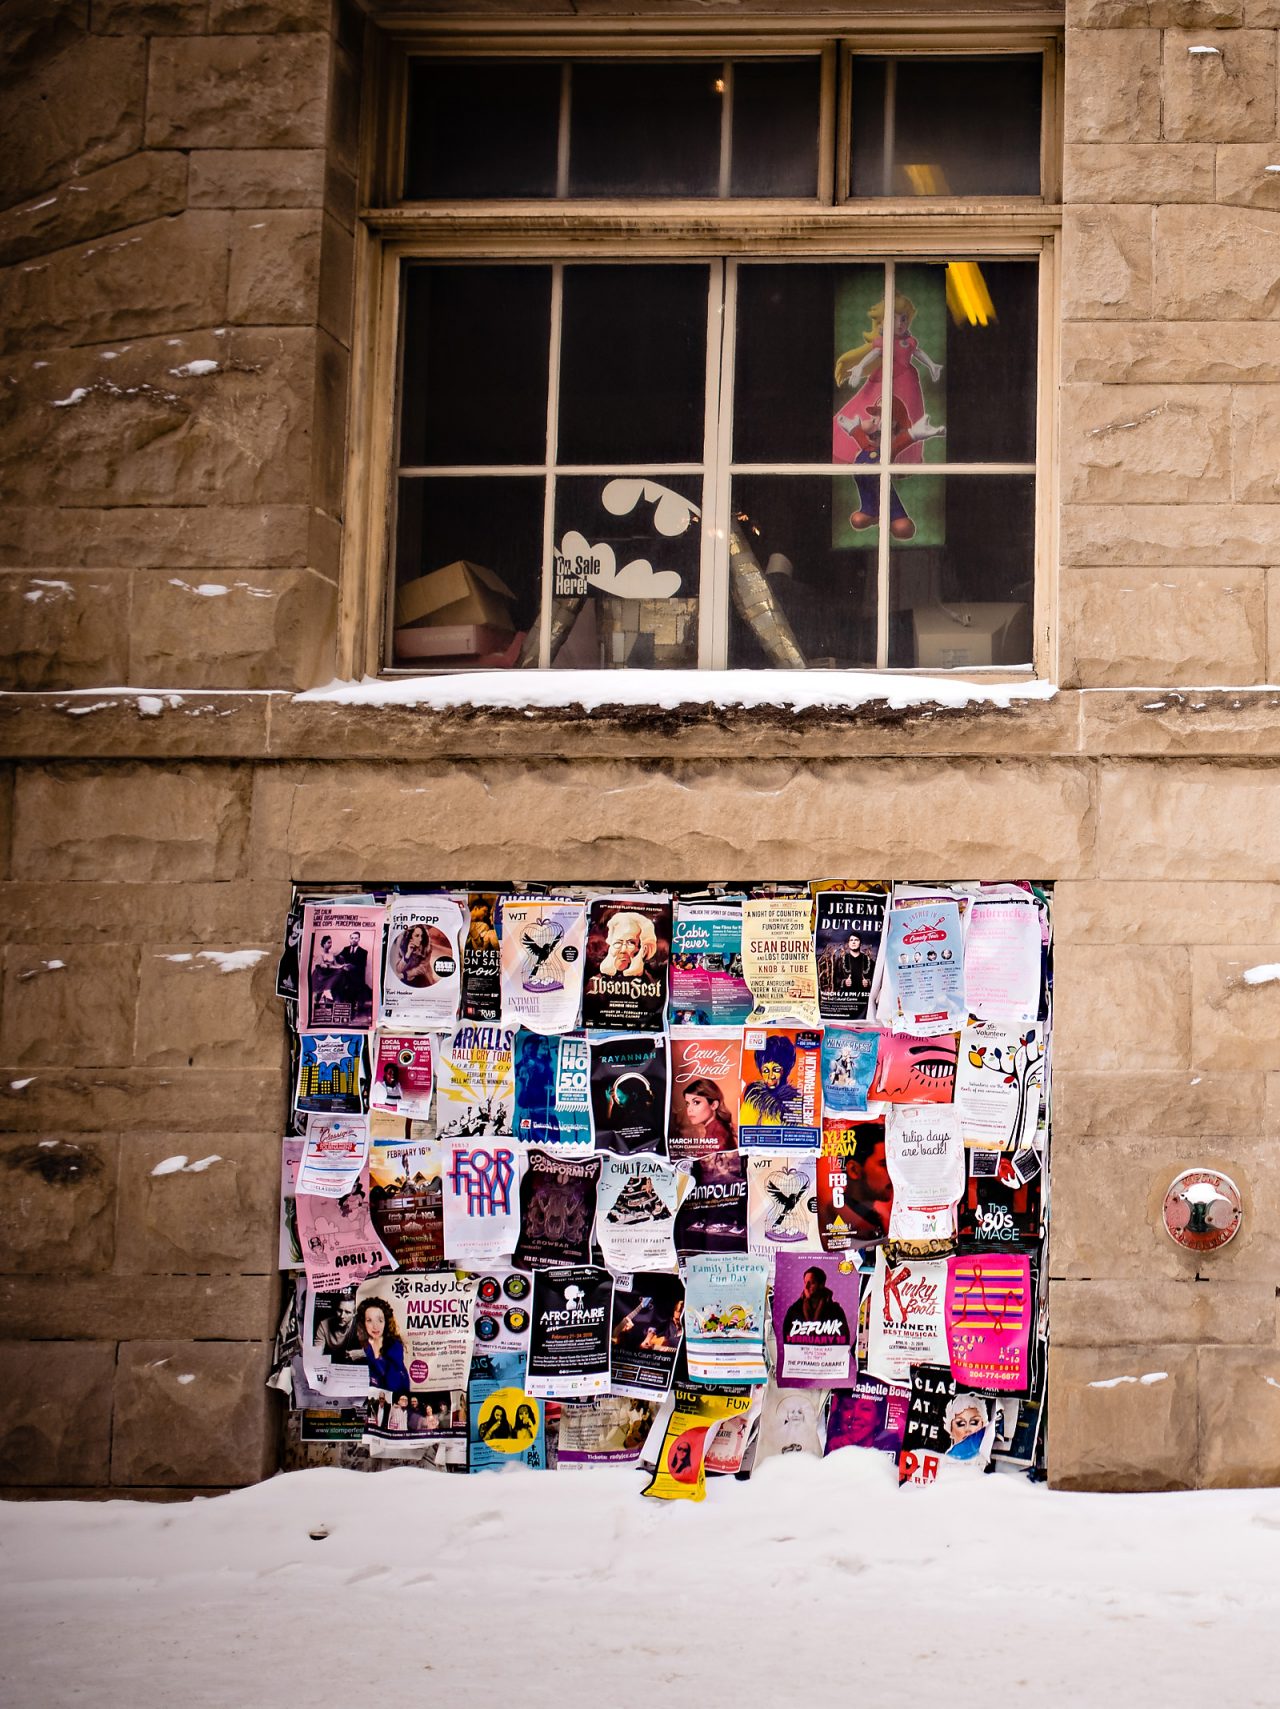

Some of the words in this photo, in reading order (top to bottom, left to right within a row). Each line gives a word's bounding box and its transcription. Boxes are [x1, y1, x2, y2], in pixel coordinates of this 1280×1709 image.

[574, 555, 601, 575] Sale
[556, 575, 588, 595] Here!
[411, 914, 440, 924] Propp
[509, 912, 527, 921] WJT
[676, 922, 711, 939] Cabin
[821, 918, 883, 932] DUTCHE
[672, 936, 711, 954] Fever
[750, 940, 778, 953] SEAN
[780, 940, 814, 953] BURNS
[465, 950, 501, 958] TICKET
[764, 953, 779, 961] LOST
[780, 953, 809, 961] COUNTRY
[482, 959, 501, 967] SAL
[758, 965, 778, 973] KNOB
[781, 965, 786, 973] &
[790, 965, 809, 973] TUBE
[586, 976, 662, 999] IbsenFest
[480, 1009, 496, 1020] RWB
[453, 1026, 514, 1051] ARKELLS
[975, 1029, 1007, 1037] Volunteer
[452, 1049, 474, 1061] RALLY
[475, 1049, 489, 1061] CRY
[493, 1051, 512, 1063] TOUR
[562, 1056, 587, 1070] HO
[601, 1052, 657, 1063] RAYANNAH
[560, 1072, 587, 1088] 50
[803, 1056, 816, 1094] FRANKLIN
[802, 1095, 814, 1126] ARETHA
[902, 1130, 924, 1147] tulip
[926, 1130, 951, 1147] days
[386, 1148, 417, 1159] FEBRUARY
[418, 1146, 432, 1156] 16TH
[820, 1142, 858, 1157] SHAW
[901, 1147, 919, 1157] are
[920, 1142, 947, 1156] back!
[533, 1163, 596, 1178] CONFORMITY
[586, 1162, 599, 1171] OF
[641, 1163, 663, 1174] 2NA
[753, 1160, 772, 1169] WJT
[828, 1173, 847, 1188] FEB
[688, 1182, 747, 1200] AMPOLINE
[832, 1187, 845, 1209] 6
[988, 1202, 1008, 1213] The
[981, 1212, 1014, 1232] 80s
[975, 1227, 1020, 1241] IMAGE
[531, 1240, 569, 1248] CROWBAR
[335, 1252, 368, 1268] APRIL
[692, 1263, 722, 1274] Family
[726, 1263, 765, 1274] Literacy
[730, 1274, 747, 1284] Day
[415, 1280, 447, 1295] Rady
[448, 1281, 473, 1293] JCC
[883, 1264, 938, 1324] Kinky
[406, 1299, 458, 1314] MUSIC
[480, 1302, 508, 1310] FANTASTIC
[906, 1298, 941, 1316] Boots
[406, 1313, 470, 1330] MAVENS
[540, 1310, 570, 1321] AFRO
[566, 1317, 604, 1325] FESTIVAL
[789, 1319, 843, 1337] DEFUNK
[883, 1321, 937, 1331] WINNER!
[786, 1336, 835, 1344] FEBRUARY
[953, 1359, 995, 1371] FUNDRIVE
[915, 1377, 957, 1395] CLAS
[725, 1397, 750, 1410] FUN
[912, 1399, 931, 1414] AT
[908, 1421, 939, 1439] PTE
